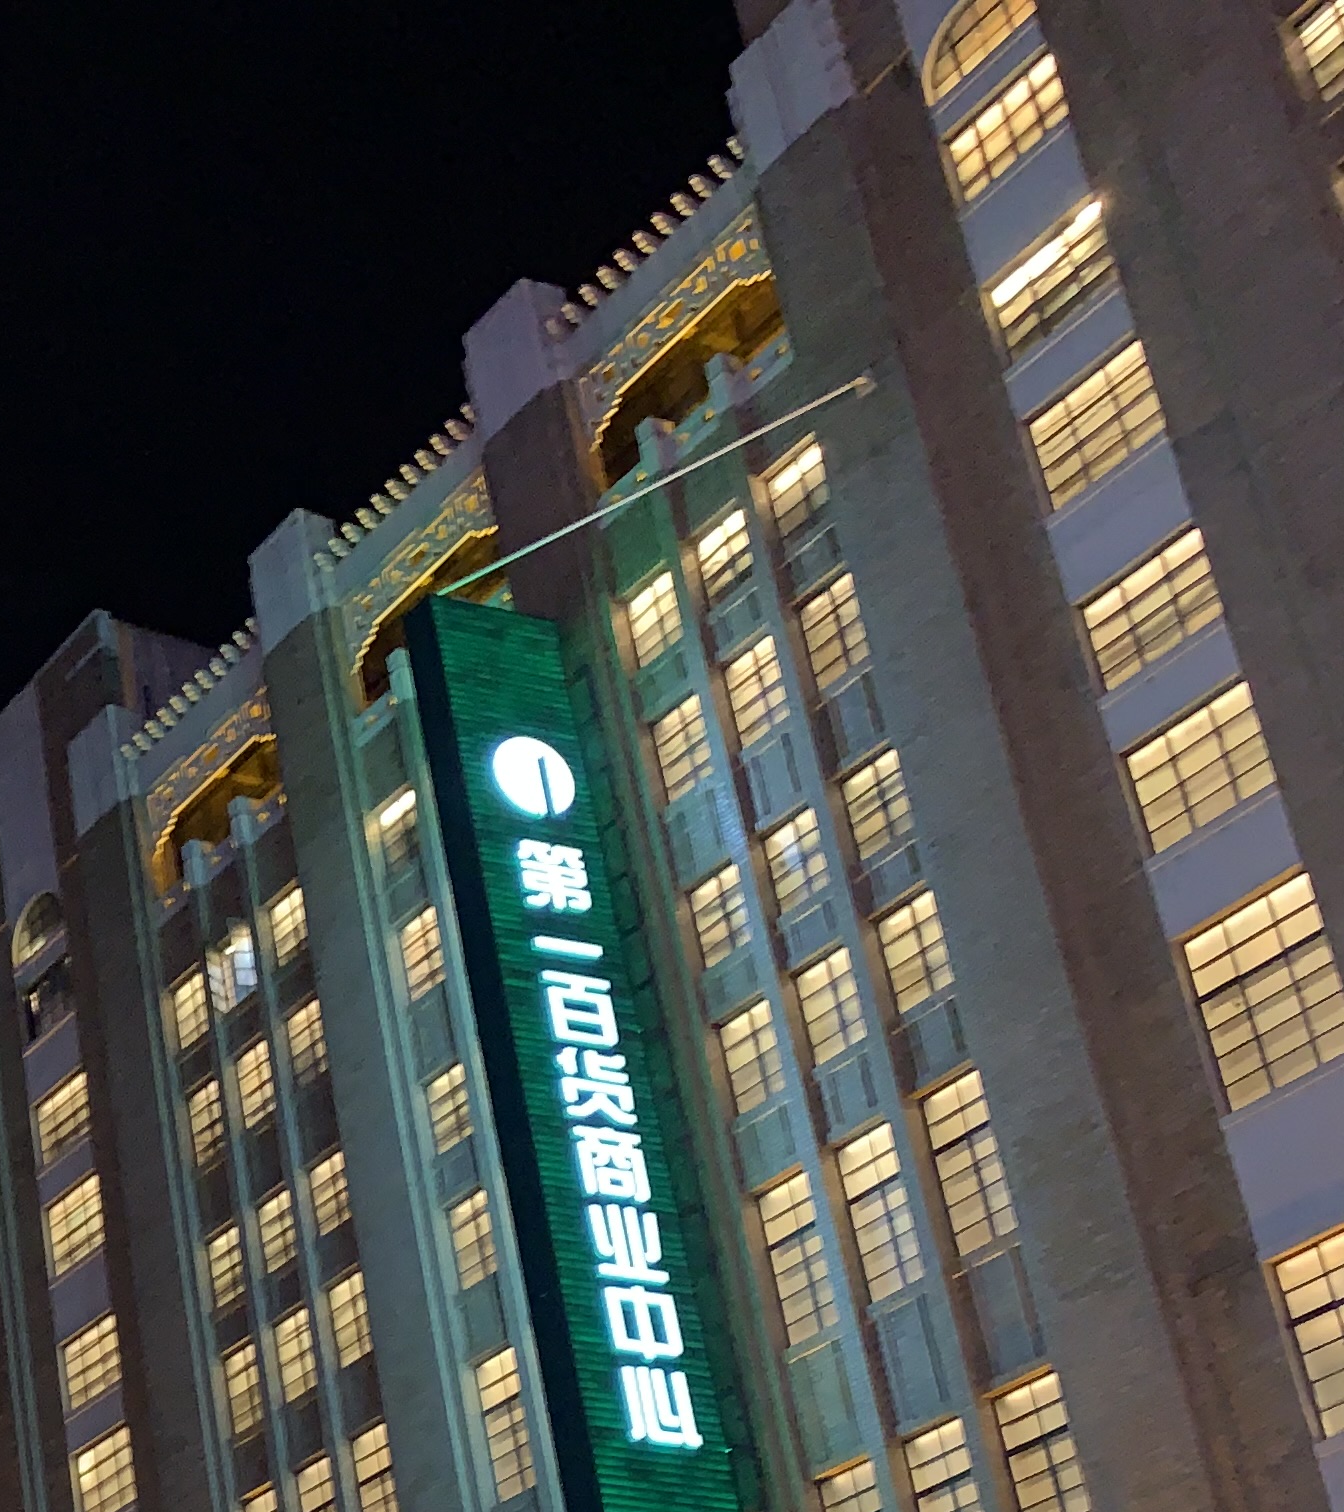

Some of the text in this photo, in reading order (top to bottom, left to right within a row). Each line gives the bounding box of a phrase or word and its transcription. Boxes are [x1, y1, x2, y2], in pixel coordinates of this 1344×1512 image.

[516, 838, 705, 1449] 第一百货商业中心
